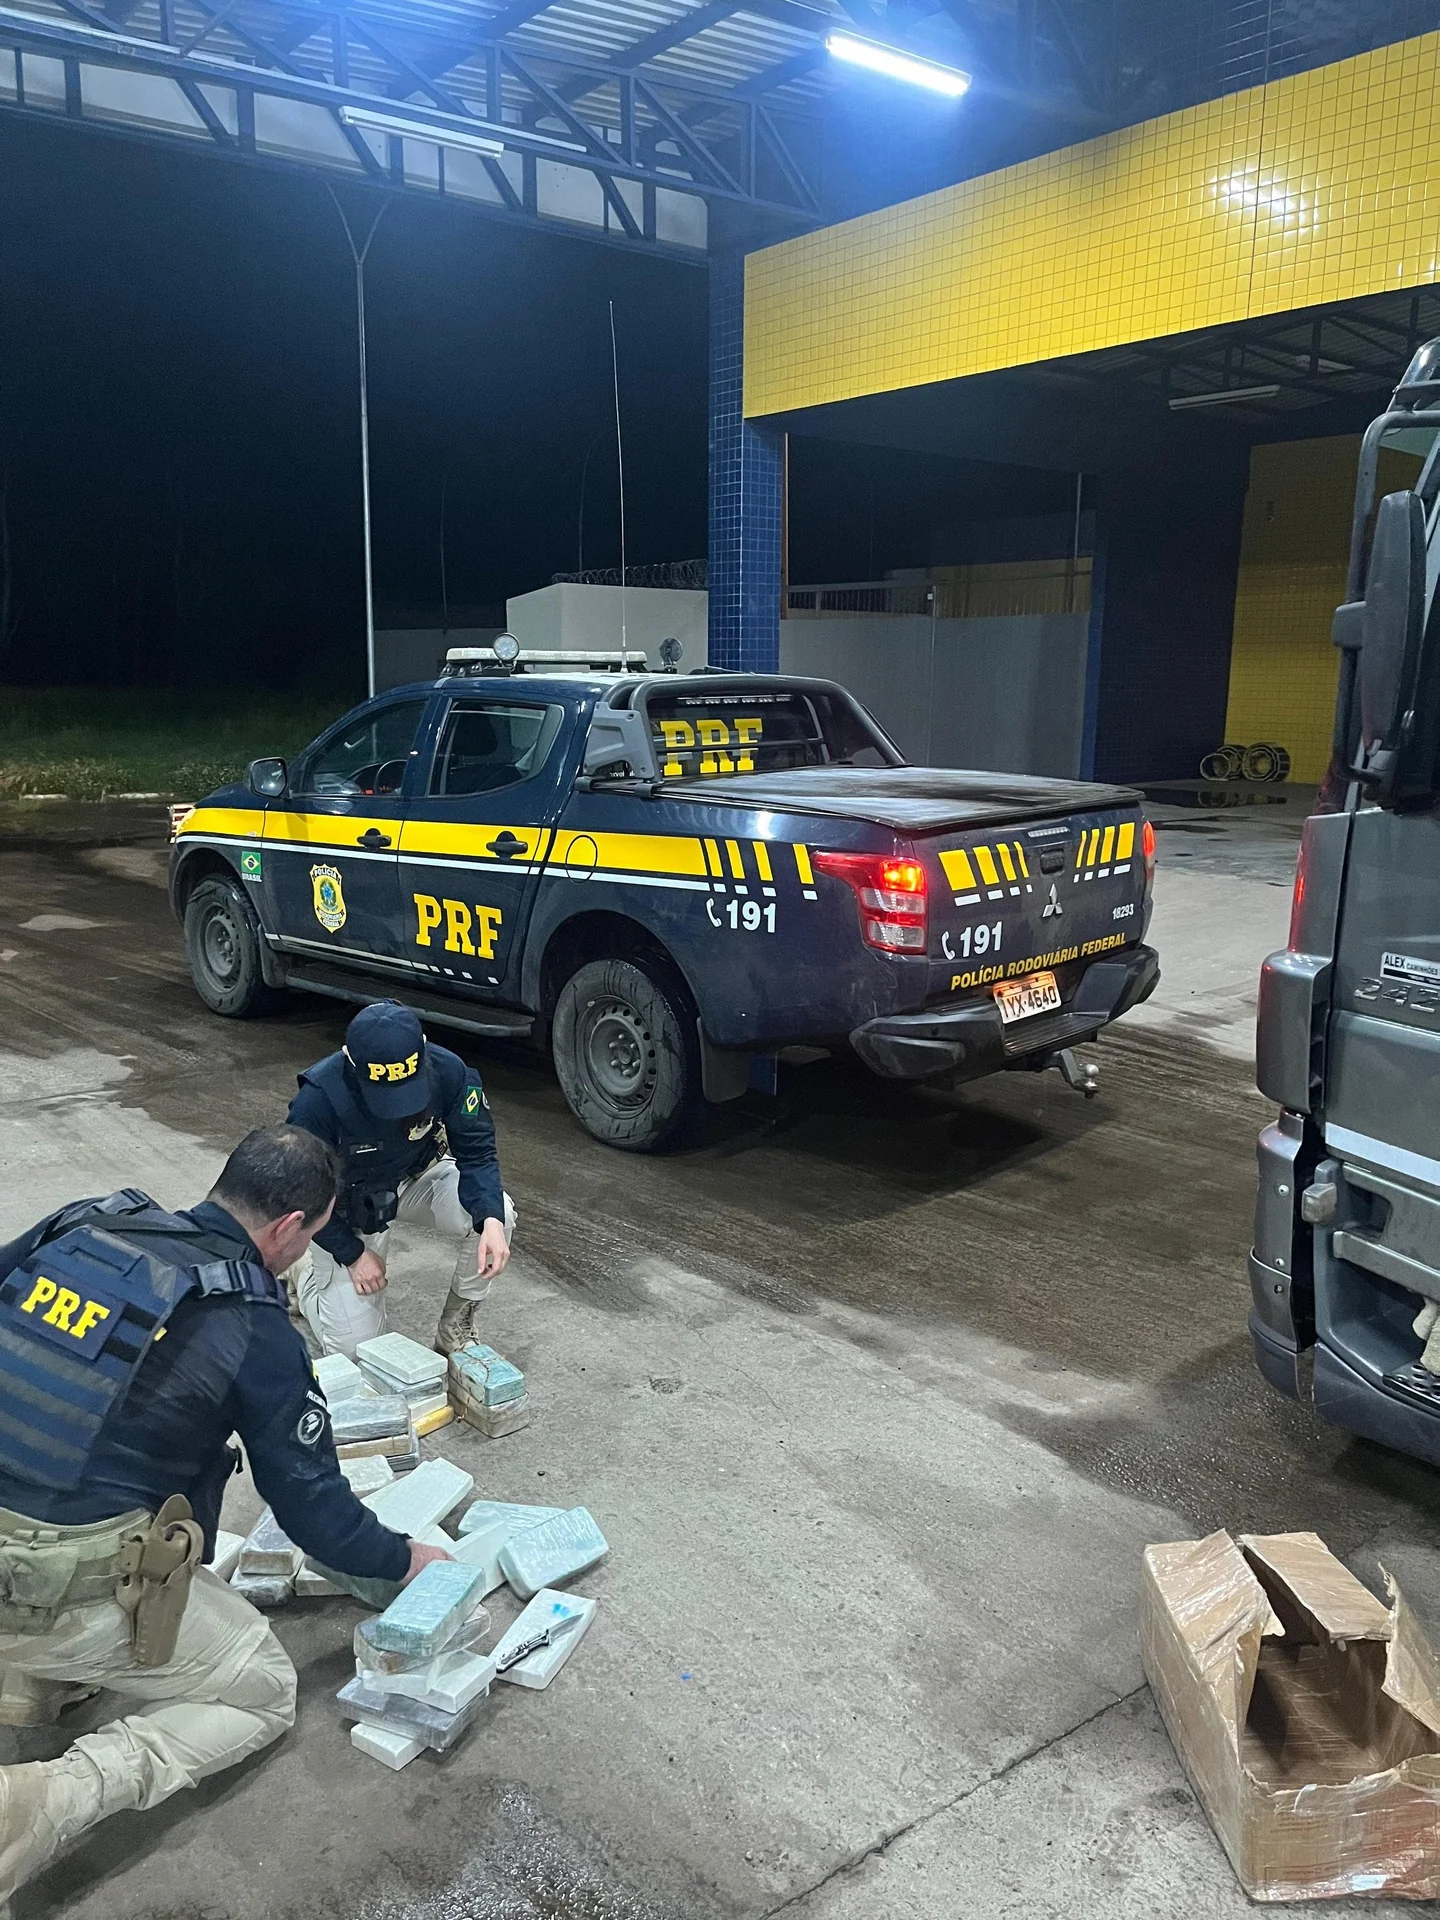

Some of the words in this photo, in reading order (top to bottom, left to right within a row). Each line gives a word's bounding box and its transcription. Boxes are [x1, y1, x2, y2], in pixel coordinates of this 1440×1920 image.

[660, 717, 763, 776] PRF
[241, 872, 263, 883] BRASIL
[413, 893, 503, 960] PRF
[725, 899, 777, 934] 191
[1112, 903, 1135, 920] 18293
[959, 921, 1004, 958] 191
[950, 964, 1004, 991] POLÍCIA
[1007, 946, 1078, 978] RODOVIÁRIA
[1081, 932, 1127, 957] FEDERAL
[1384, 954, 1406, 970] ALEX
[367, 1051, 419, 1082] PRF
[20, 1275, 111, 1340] PRF
